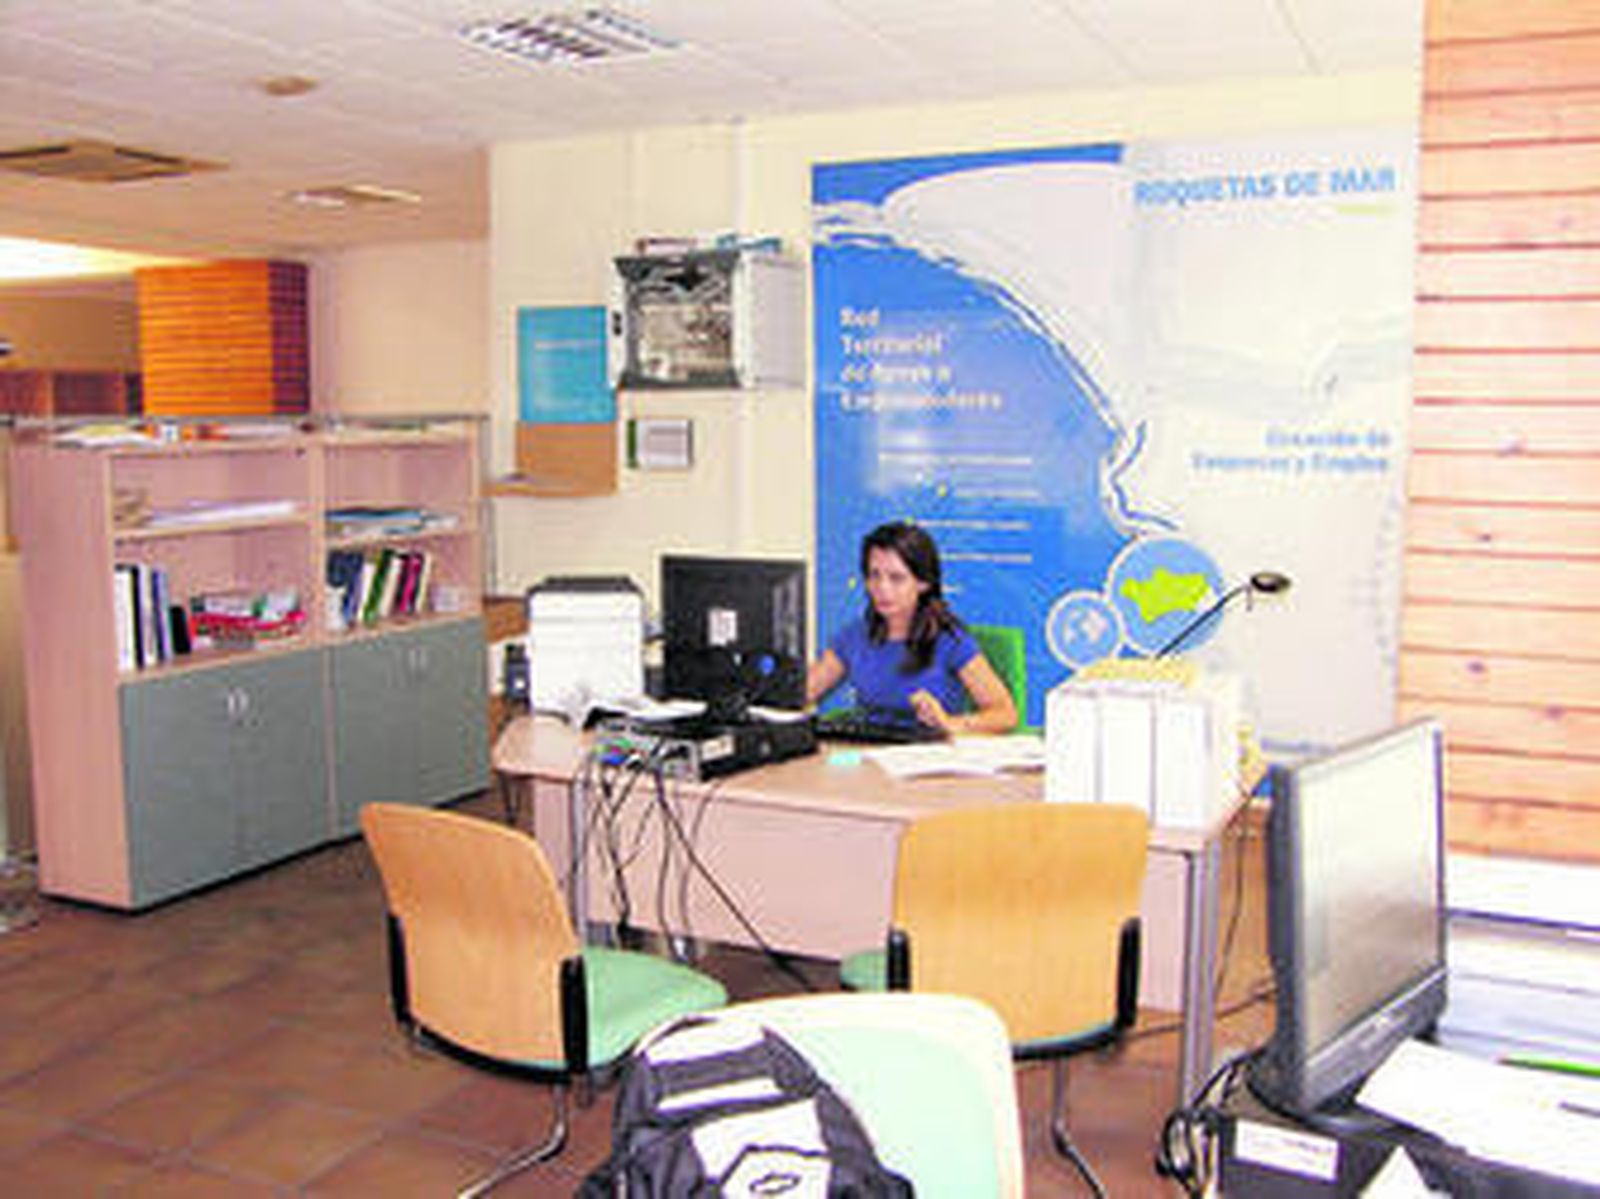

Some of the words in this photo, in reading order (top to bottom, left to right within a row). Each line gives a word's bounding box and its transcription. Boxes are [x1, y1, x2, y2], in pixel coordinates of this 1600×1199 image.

[1134, 174, 1275, 206] ROQUETAS
[1285, 171, 1318, 195] DE
[1330, 166, 1395, 193] MAR
